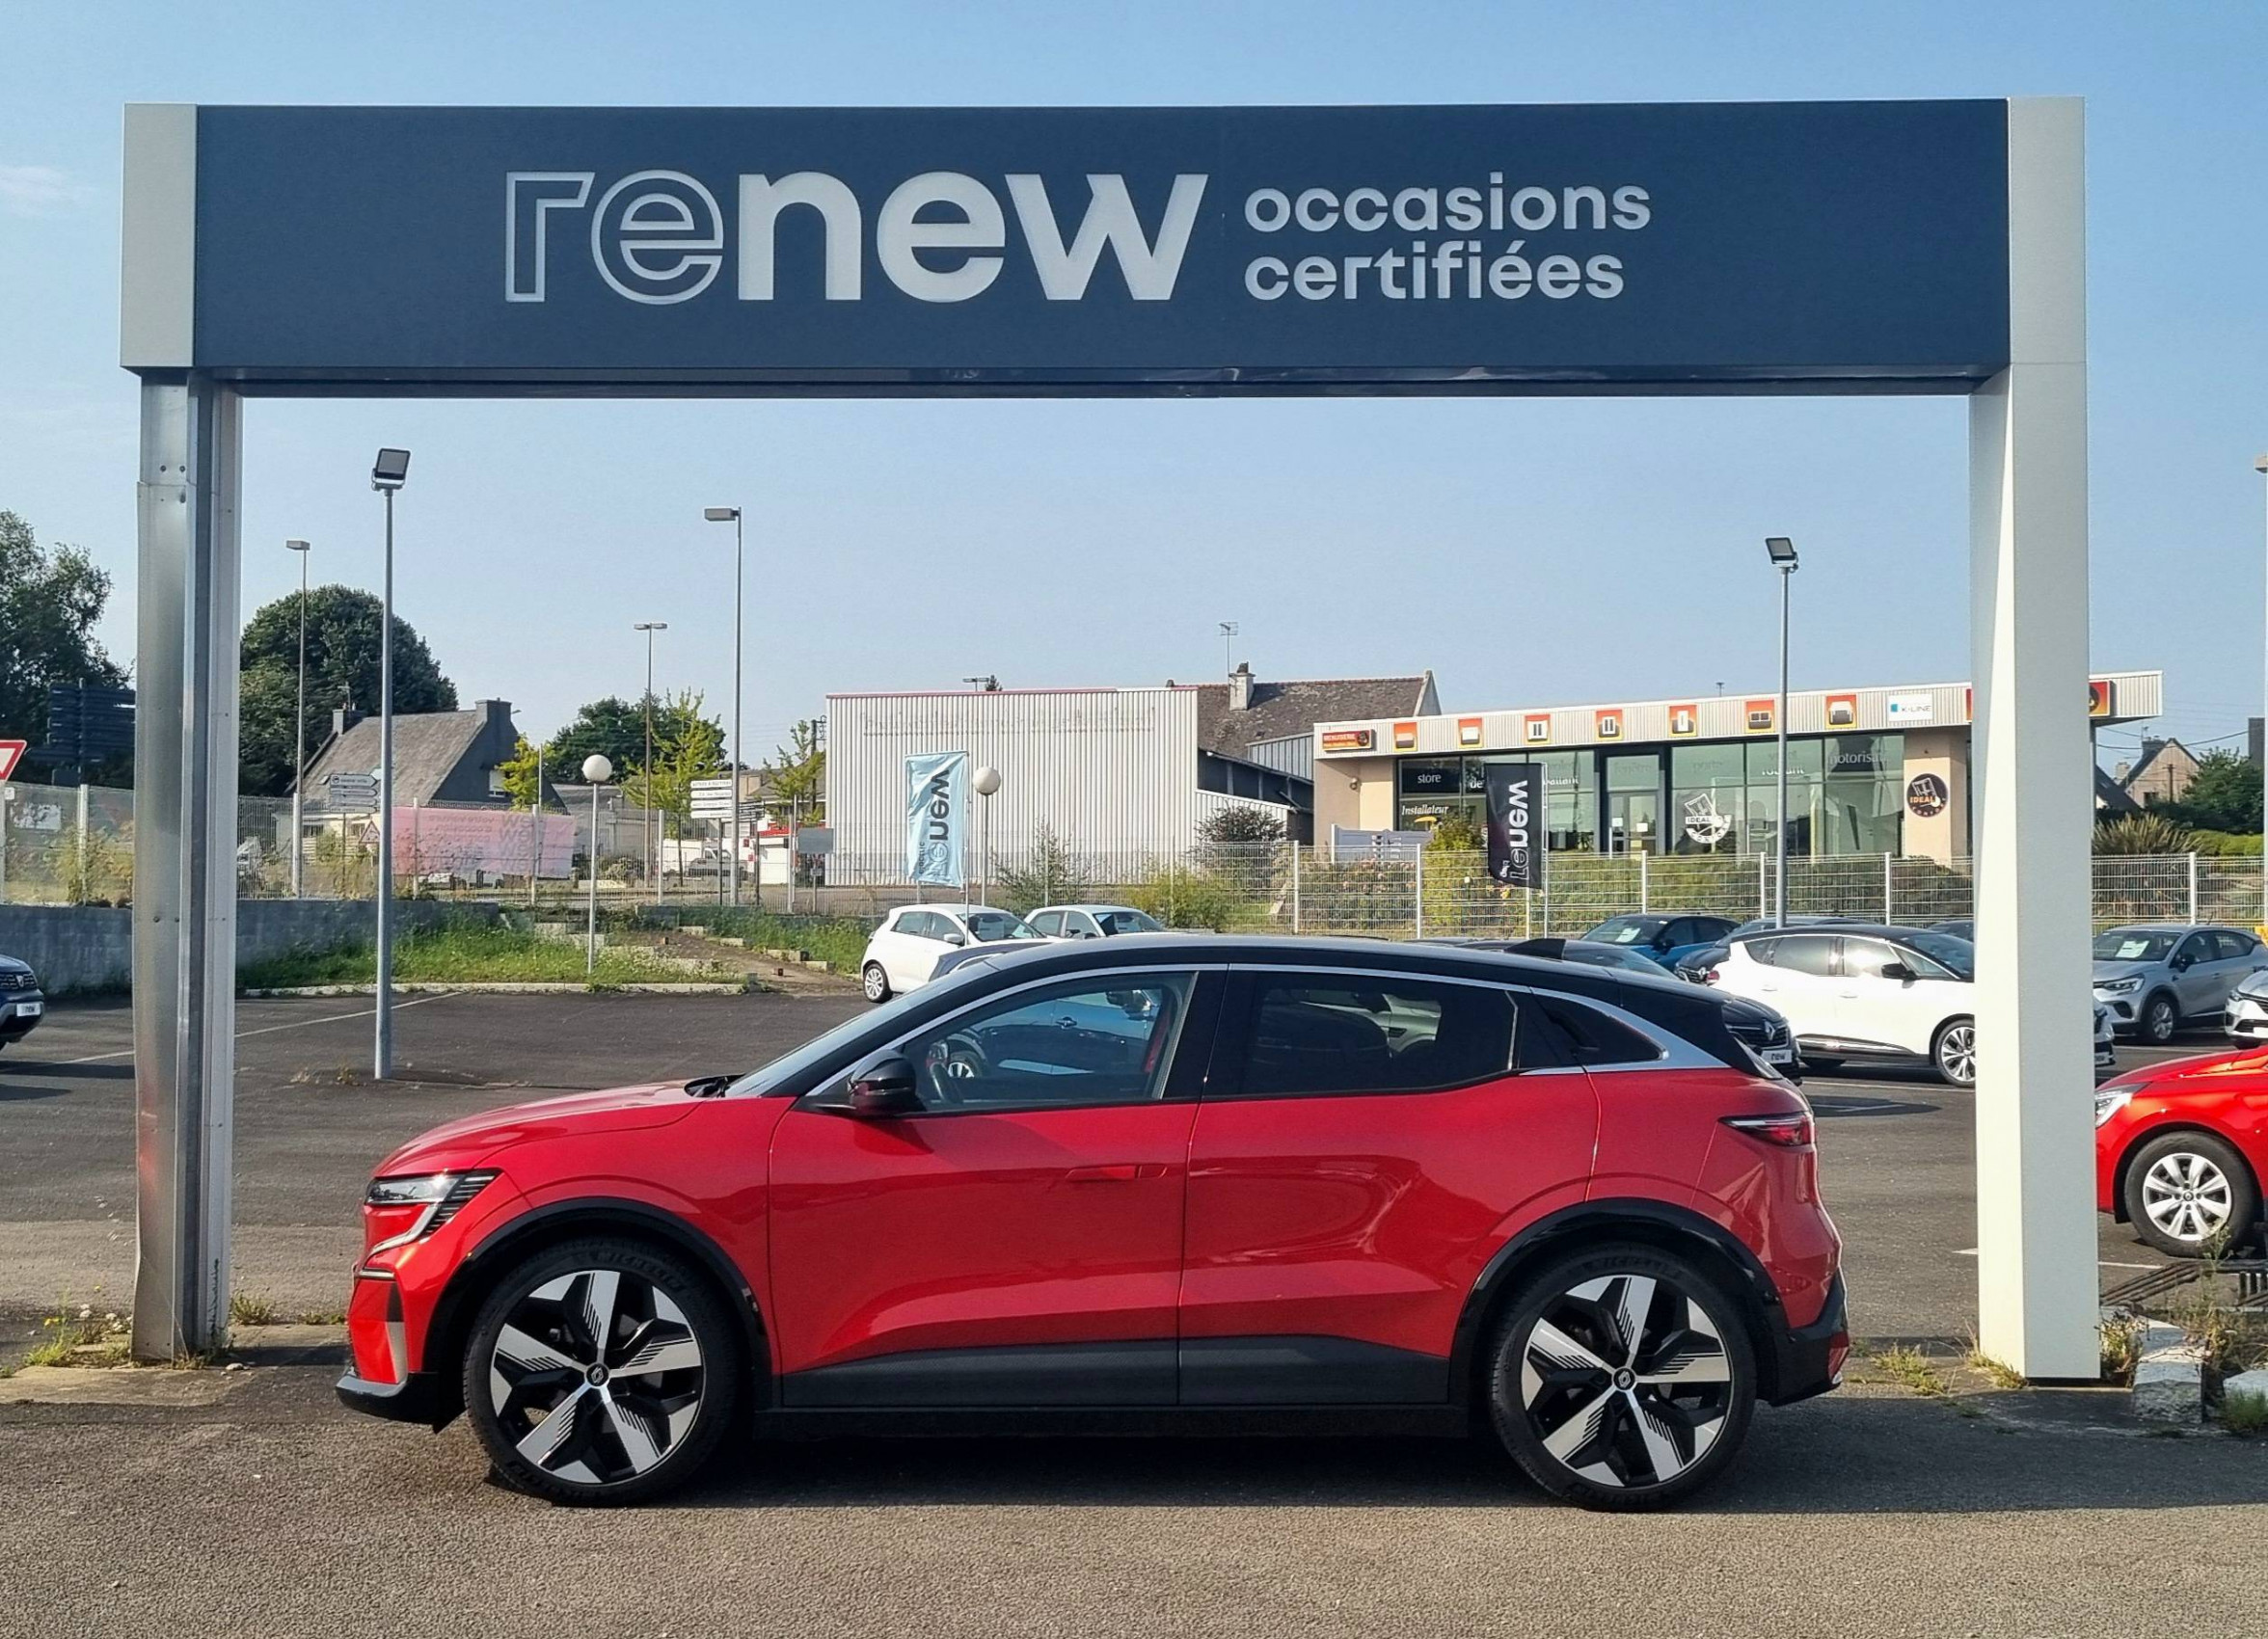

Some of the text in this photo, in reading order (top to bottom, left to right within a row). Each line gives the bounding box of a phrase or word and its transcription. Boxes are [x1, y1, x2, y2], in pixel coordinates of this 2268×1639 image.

[1244, 171, 1652, 232] occasions
[504, 169, 1209, 306] renew
[1244, 239, 1625, 301] certifiées
[1418, 773, 1442, 784] store
[1401, 804, 1449, 816] Installateur
[1909, 795, 1935, 804] IDEAL
